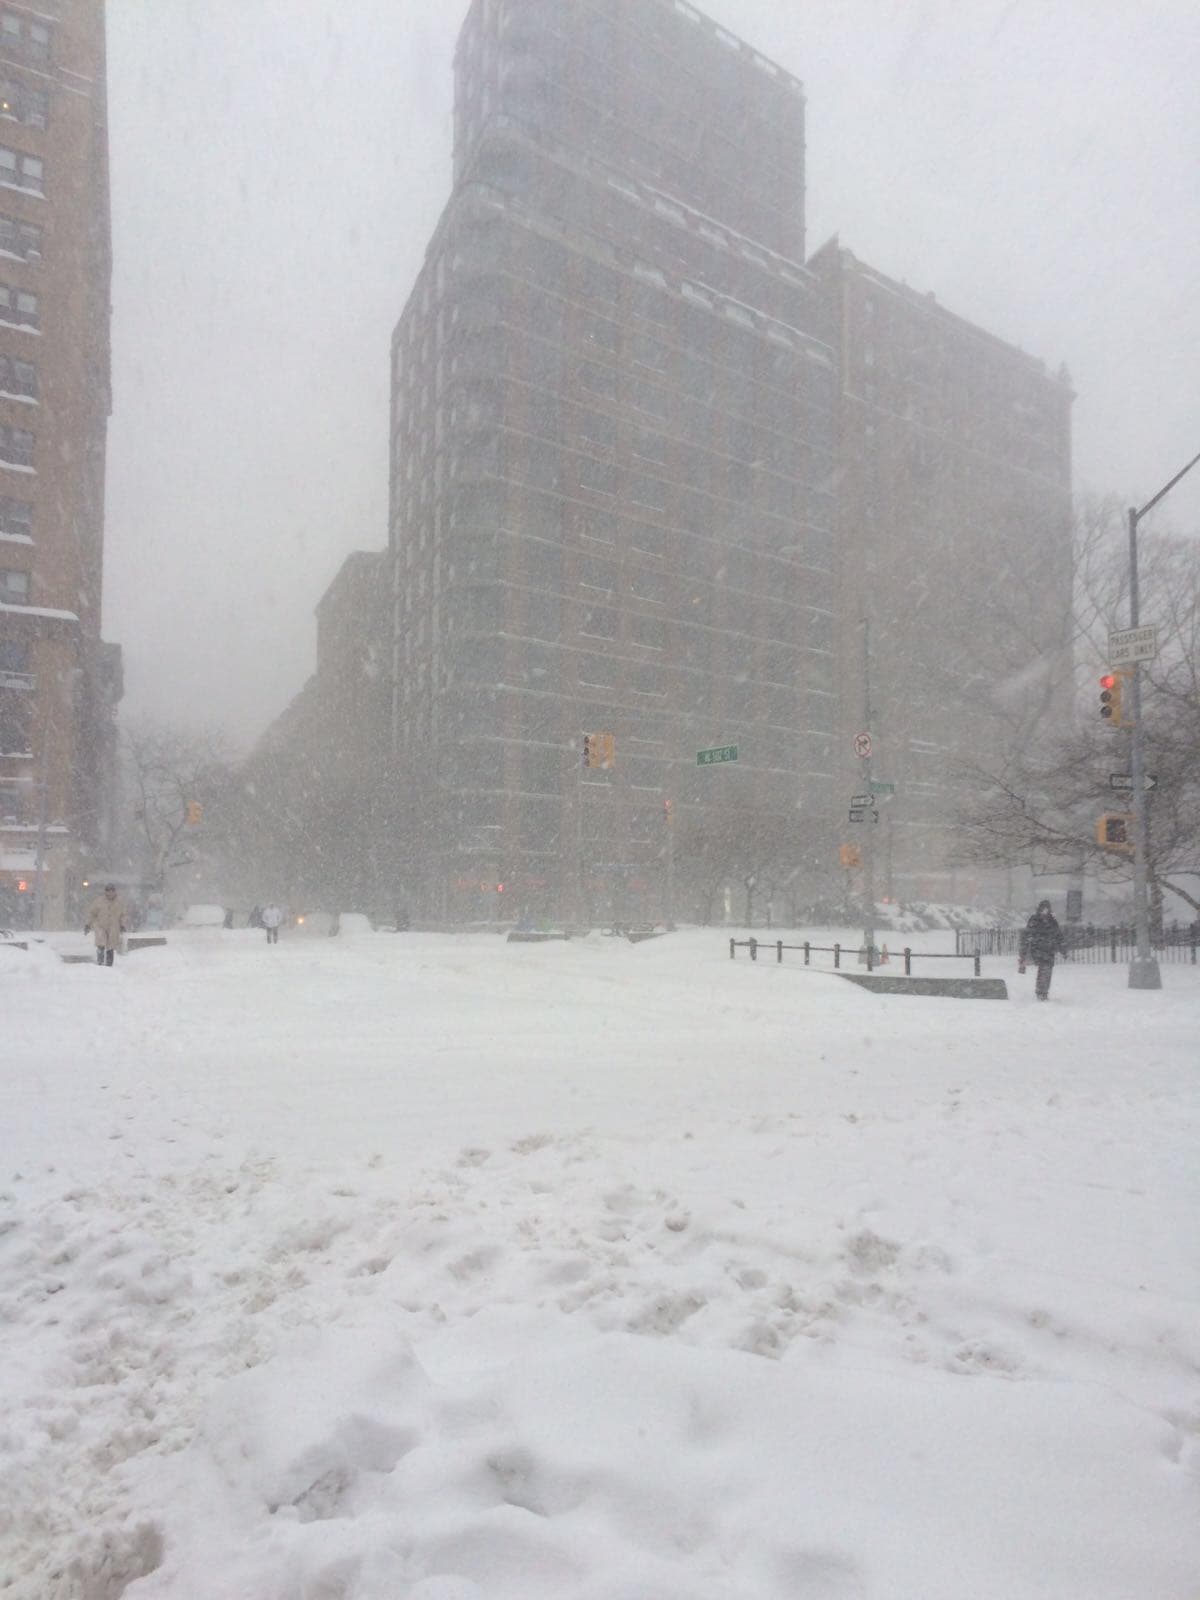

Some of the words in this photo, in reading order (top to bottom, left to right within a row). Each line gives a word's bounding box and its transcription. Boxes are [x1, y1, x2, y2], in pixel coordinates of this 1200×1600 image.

[1110, 629, 1153, 647] PASSENGER
[1111, 647, 1130, 660] CARS
[1134, 643, 1154, 656] ONLY
